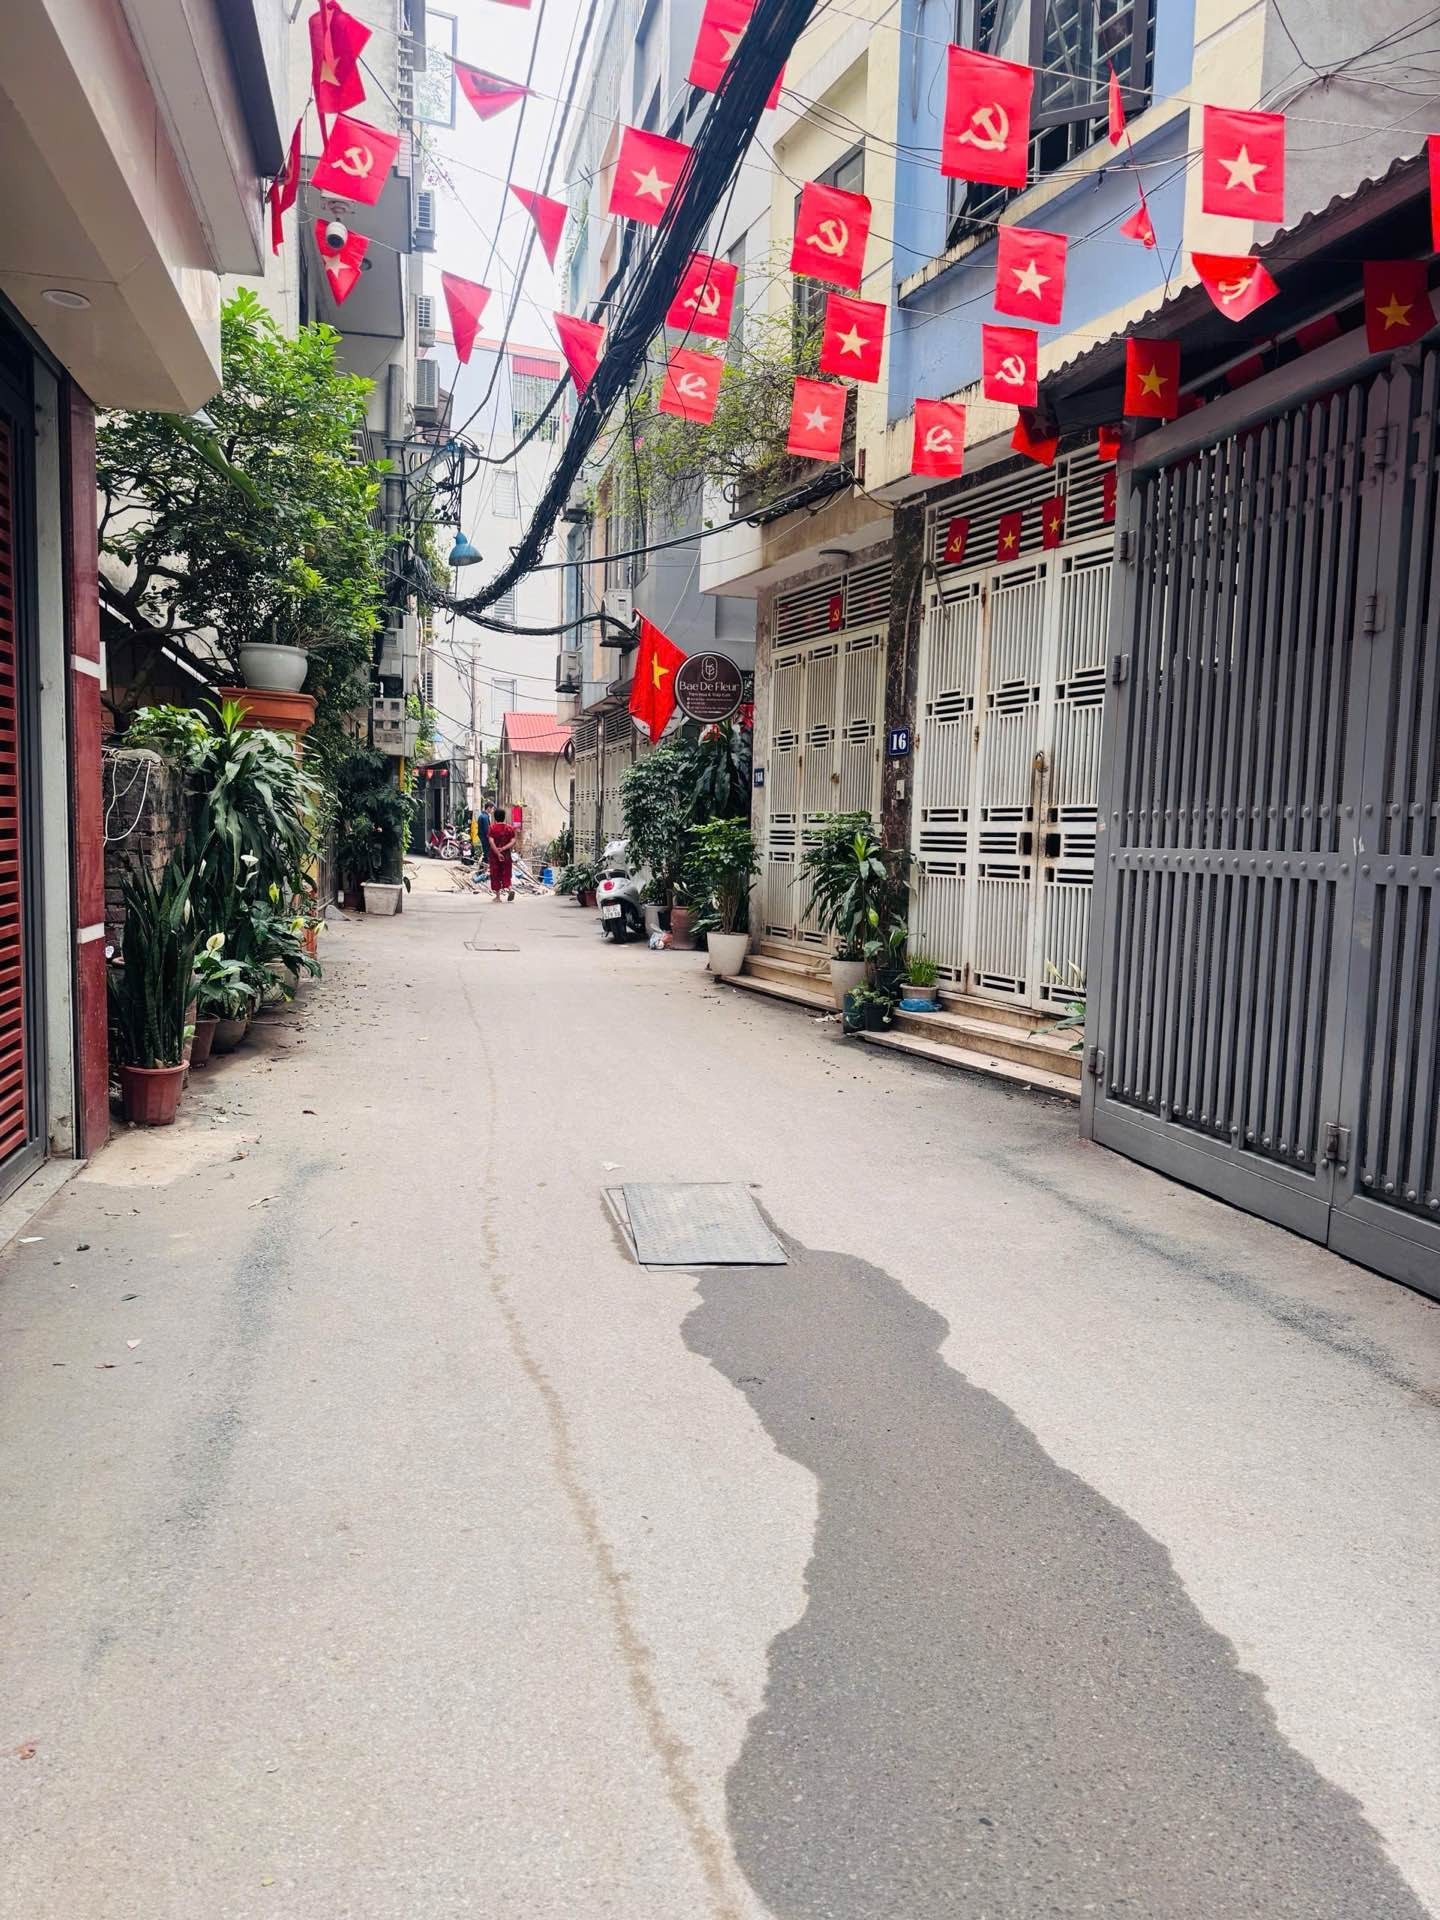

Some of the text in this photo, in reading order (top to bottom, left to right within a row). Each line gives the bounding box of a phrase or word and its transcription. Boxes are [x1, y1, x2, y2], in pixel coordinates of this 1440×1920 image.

[680, 681, 699, 691] Bae
[700, 681, 714, 691] De
[892, 732, 907, 751] 16
